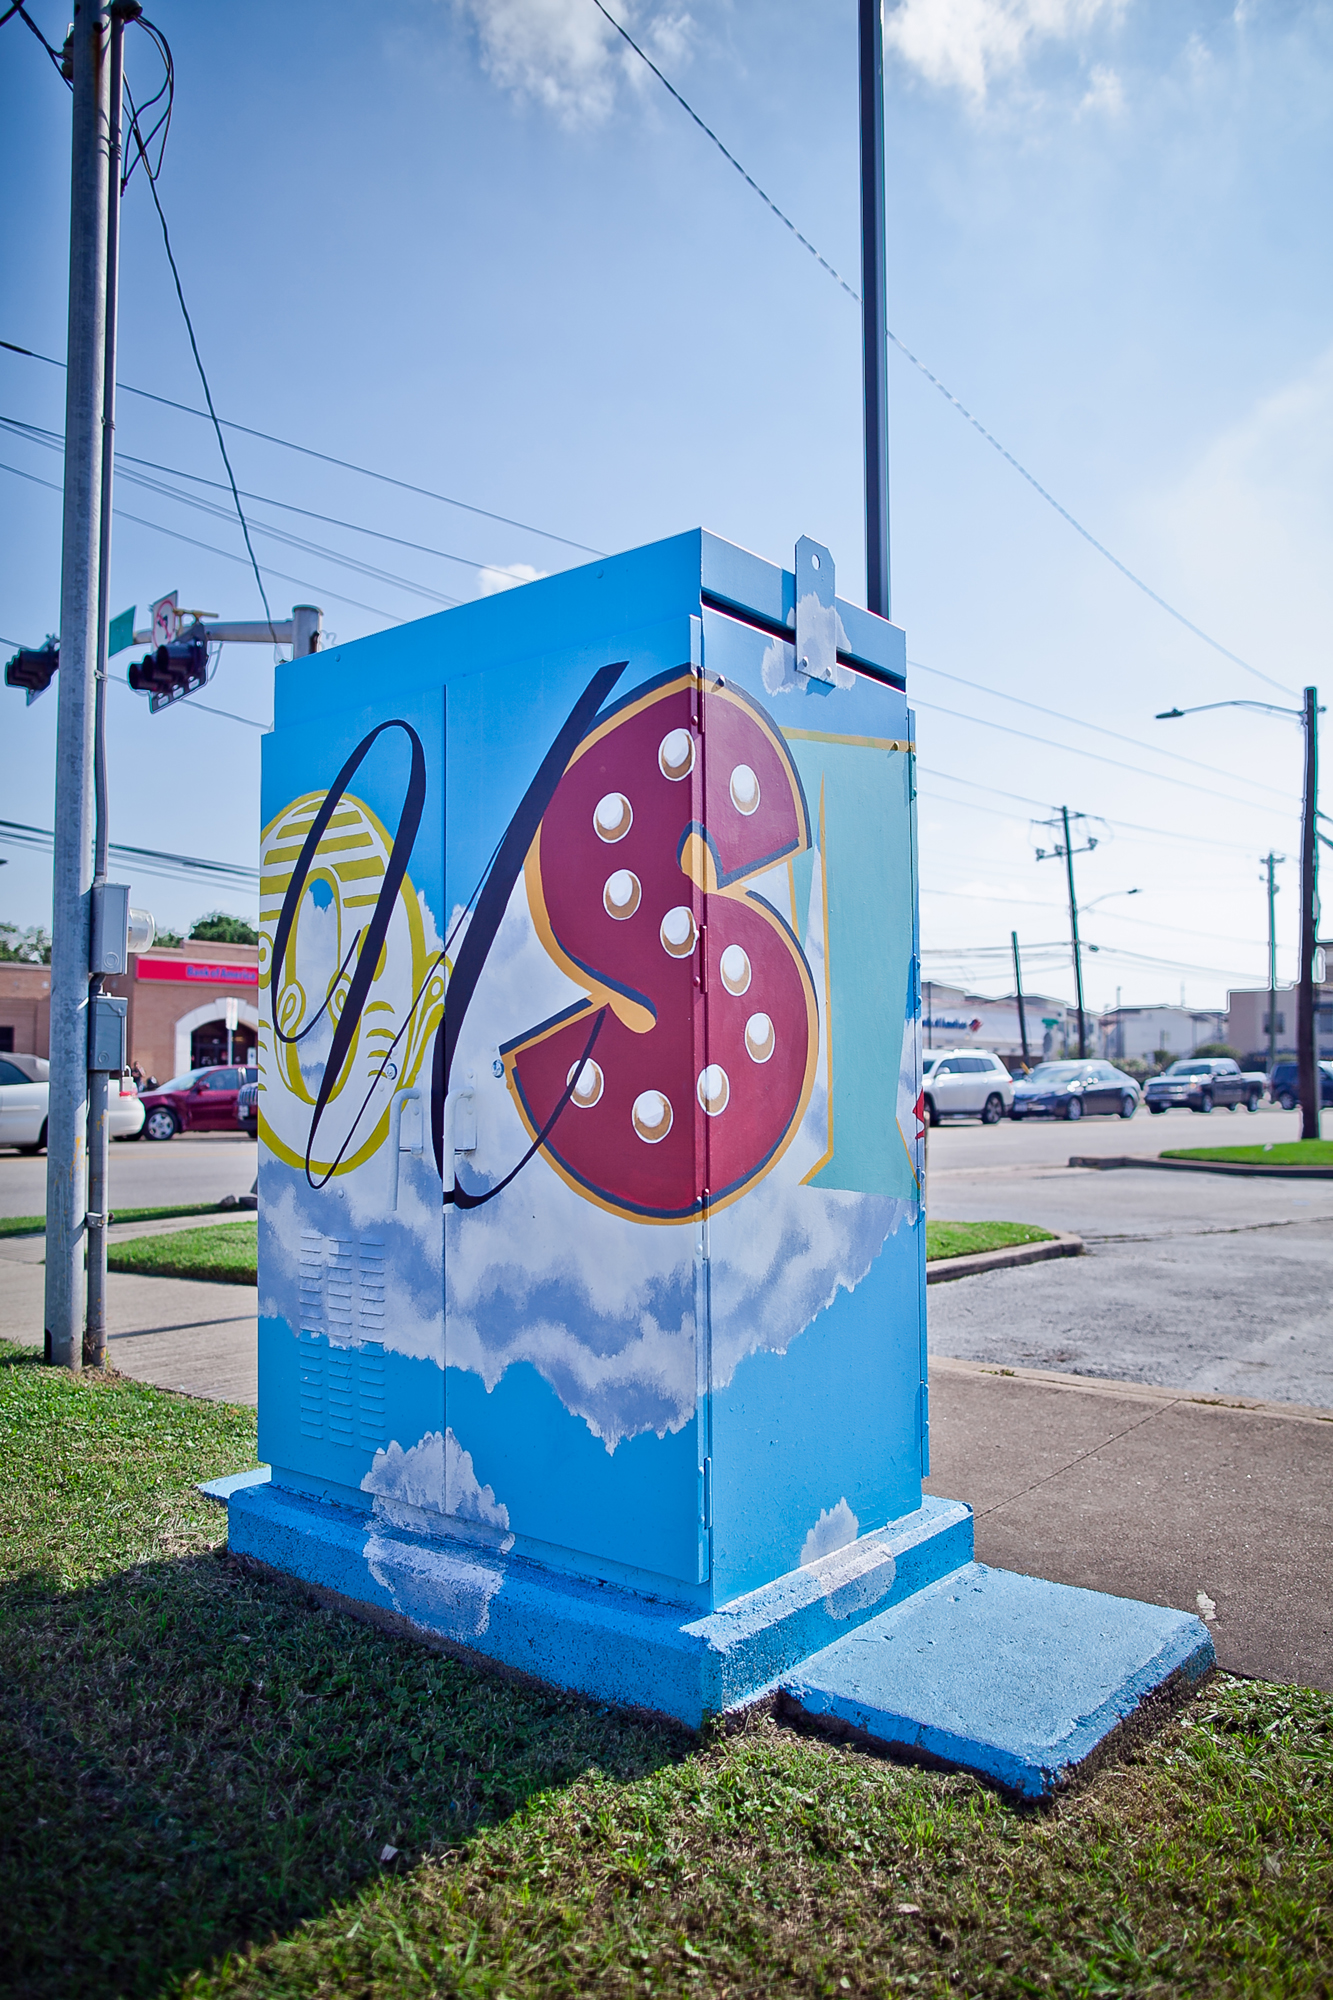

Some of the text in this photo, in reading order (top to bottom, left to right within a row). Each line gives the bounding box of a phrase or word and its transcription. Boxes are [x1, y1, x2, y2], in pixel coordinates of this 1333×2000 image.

[186, 965, 256, 981] Bank of America
